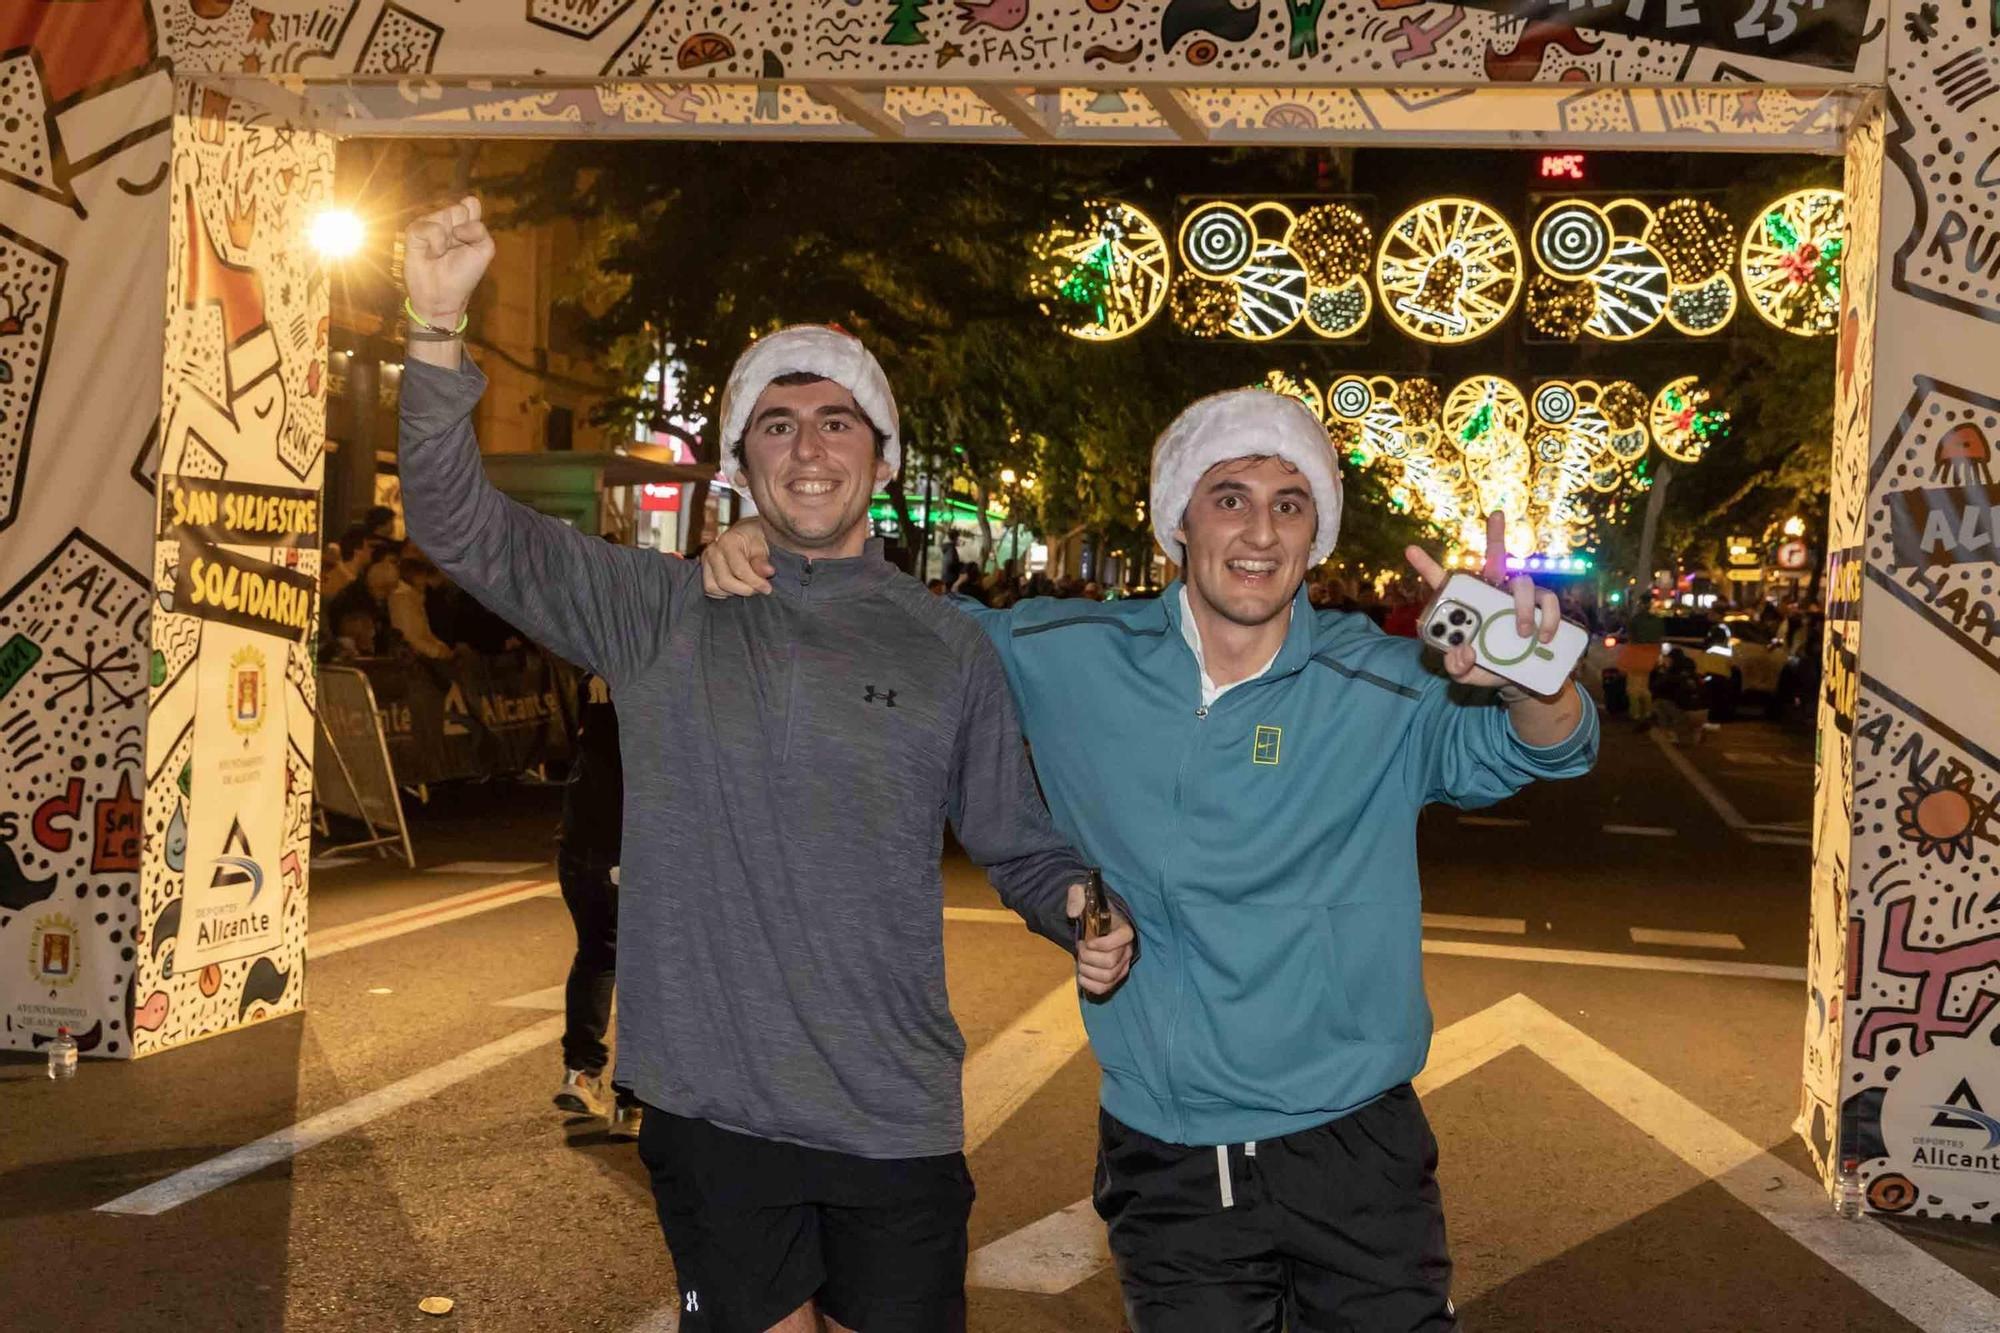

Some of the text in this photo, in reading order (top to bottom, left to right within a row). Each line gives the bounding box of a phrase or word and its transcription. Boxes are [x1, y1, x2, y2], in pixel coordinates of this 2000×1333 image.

[982, 34, 1068, 63] FAST!
[172, 487, 318, 535] SAN SILVESTRE
[190, 556, 310, 629] SOLIDARIA
[196, 911, 270, 946] Alicante
